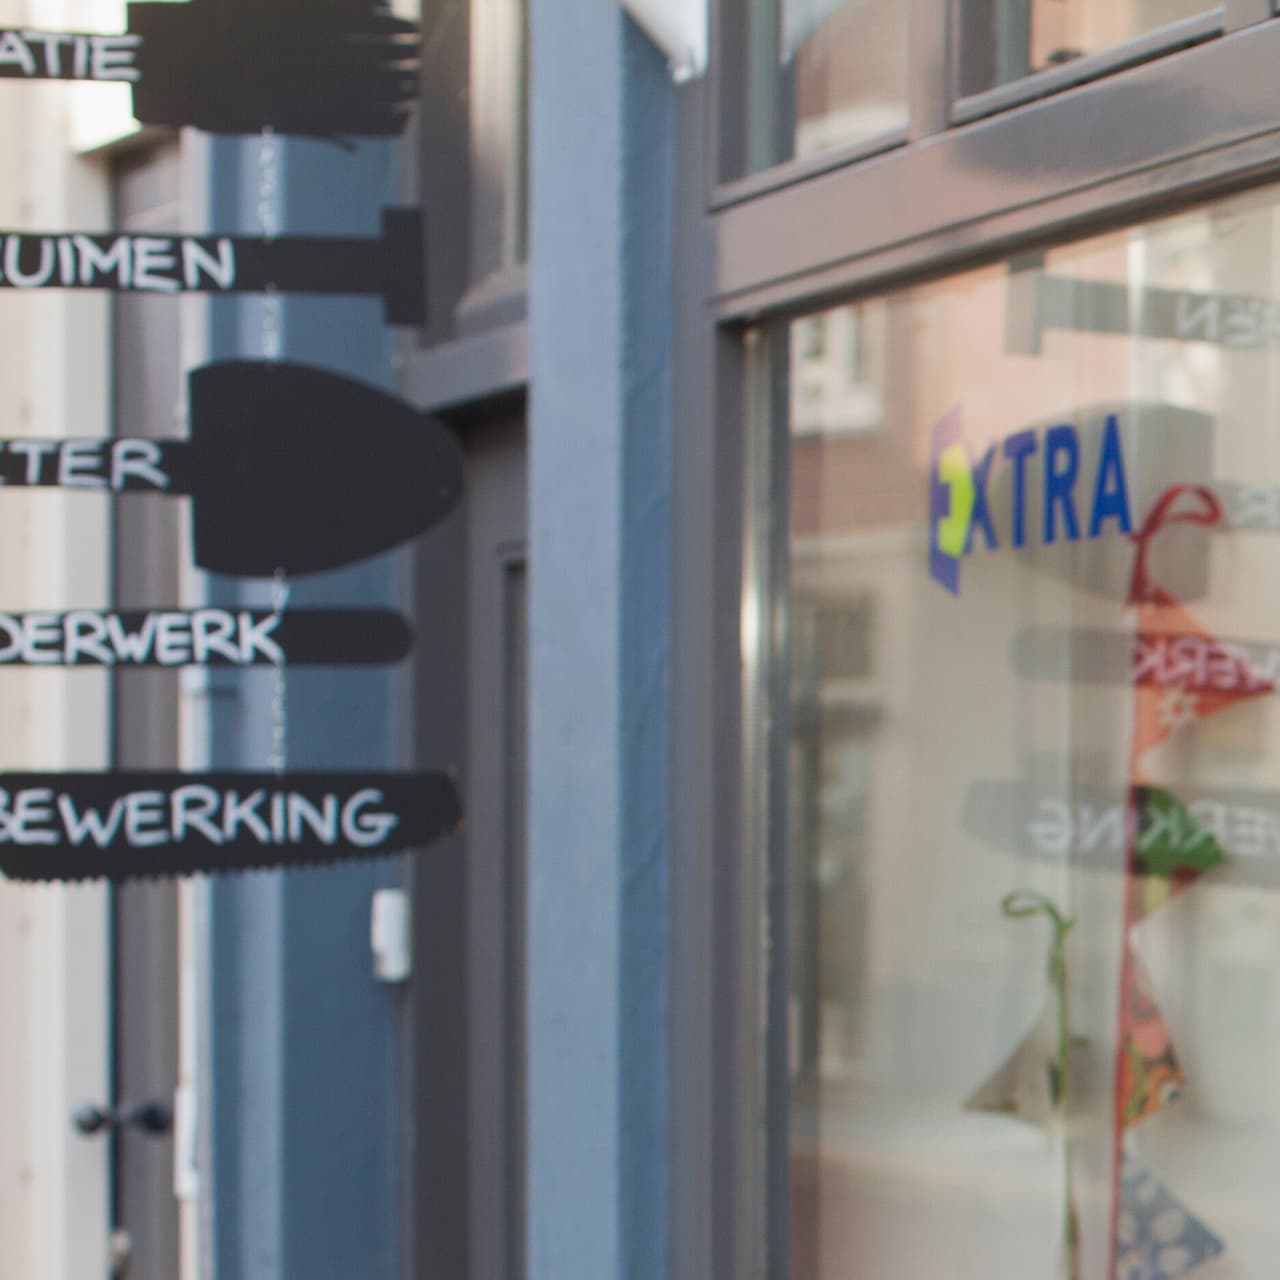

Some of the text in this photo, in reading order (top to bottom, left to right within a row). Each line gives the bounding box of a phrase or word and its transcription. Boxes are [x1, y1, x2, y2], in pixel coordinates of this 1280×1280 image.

[0, 30, 143, 82] ATIE
[0, 234, 237, 292] UIMEN
[0, 437, 171, 490] TER
[928, 405, 1133, 597] EXTRA
